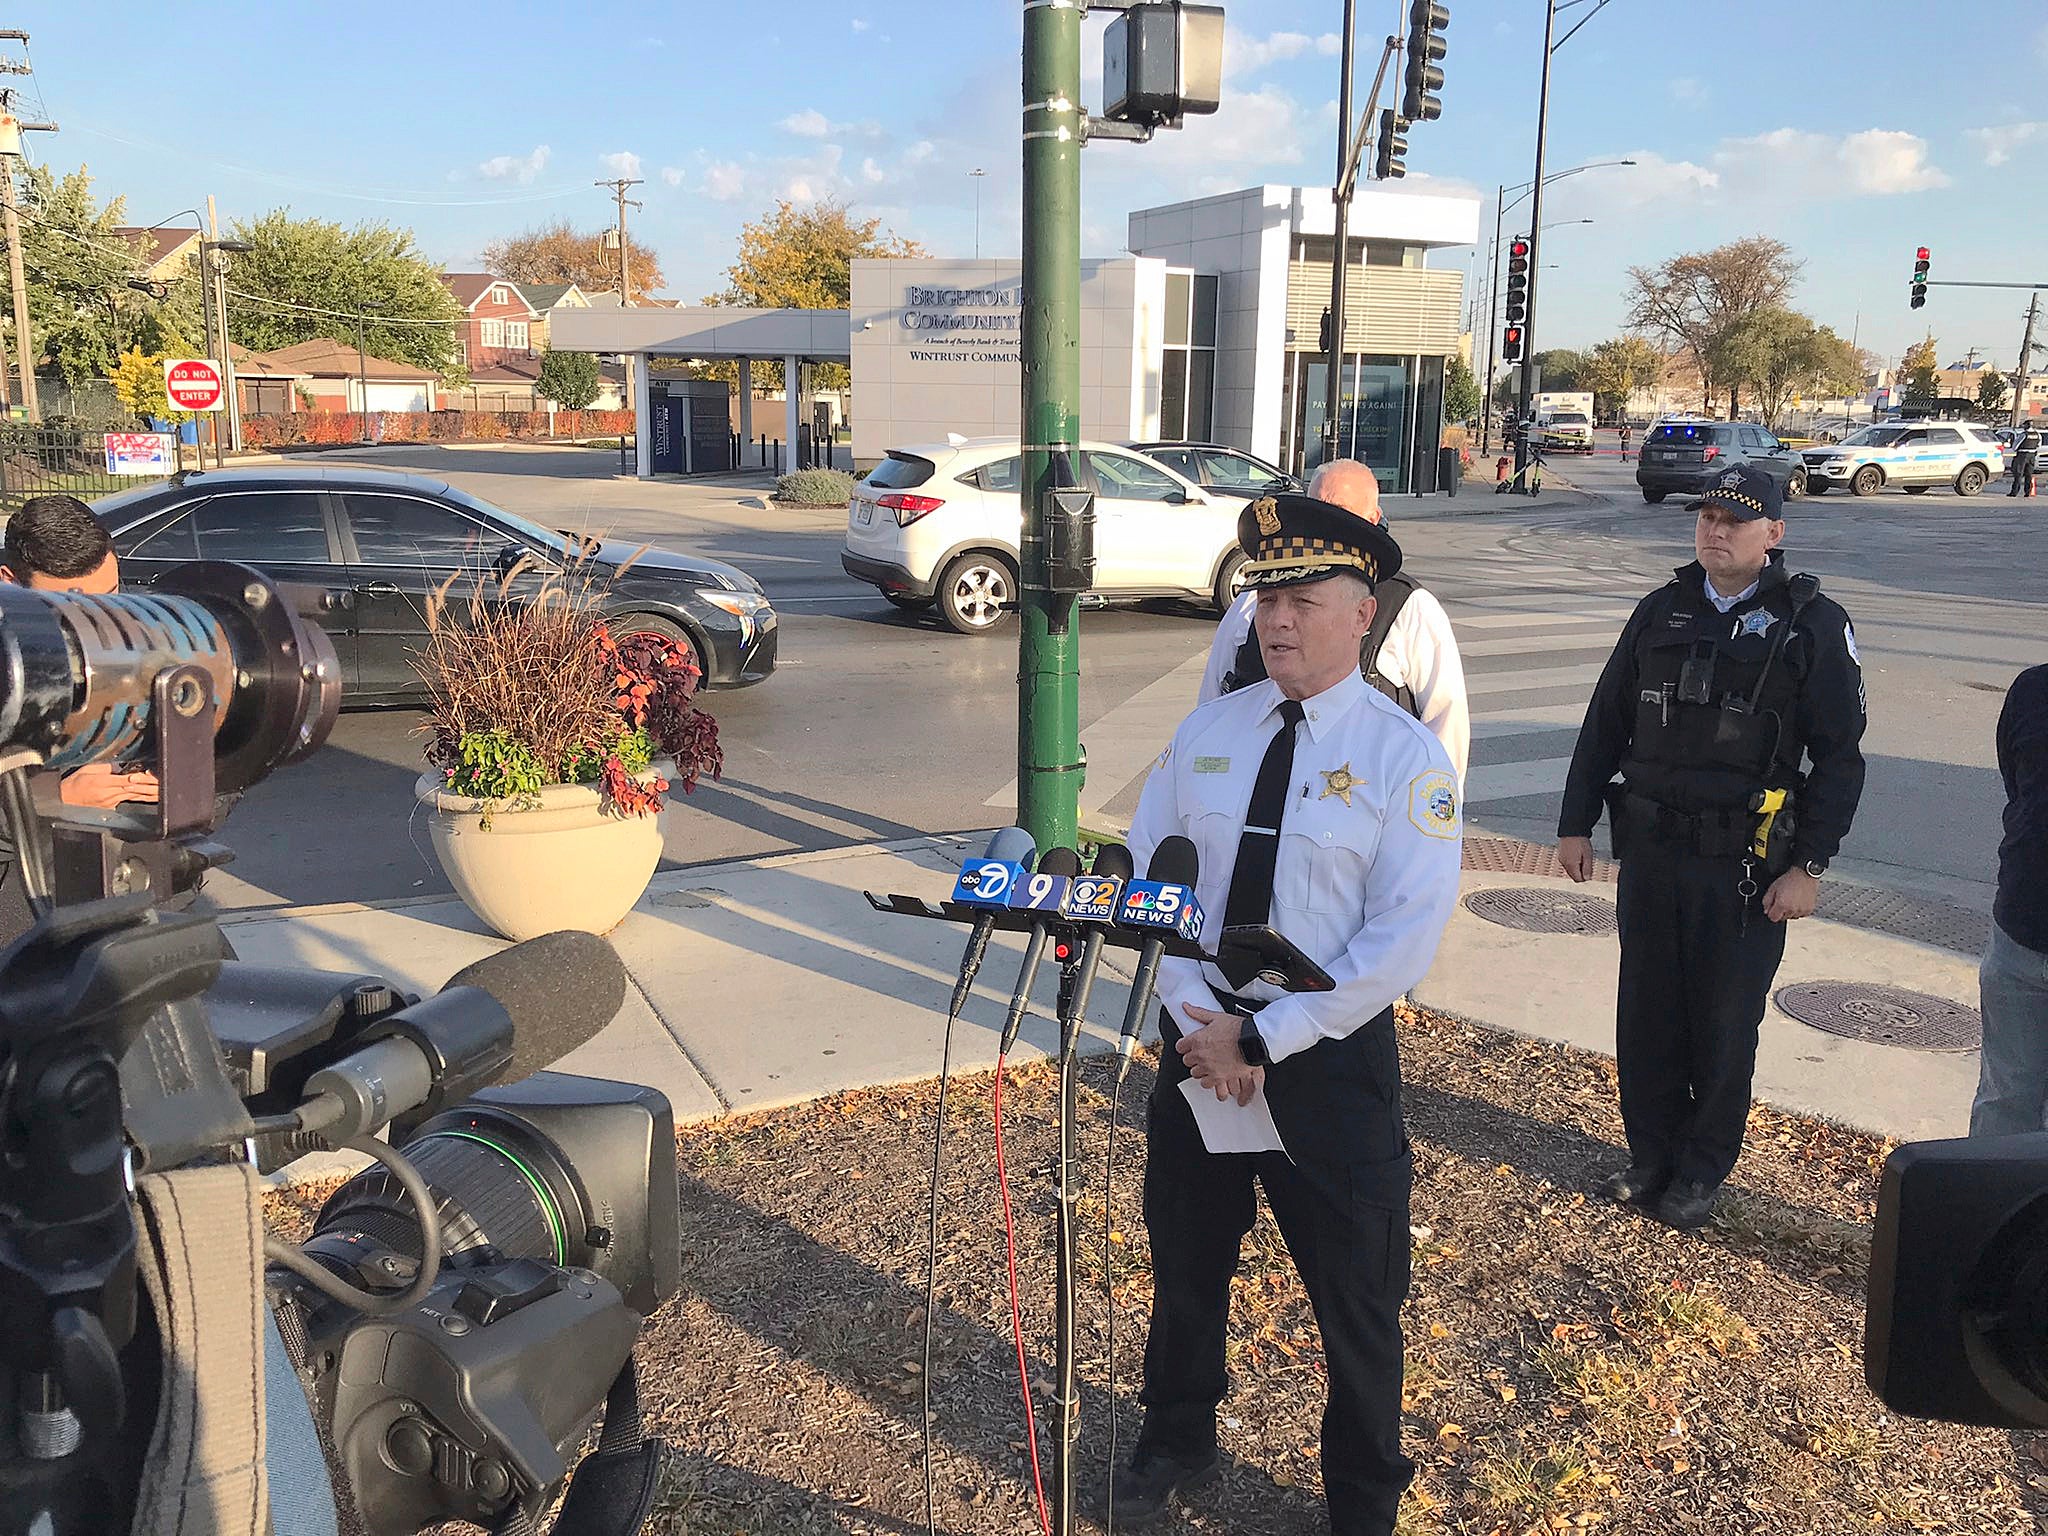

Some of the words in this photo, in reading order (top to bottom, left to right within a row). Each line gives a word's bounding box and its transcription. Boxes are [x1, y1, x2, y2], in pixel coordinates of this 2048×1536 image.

[911, 286, 1011, 306] BRIGHTON
[904, 311, 1018, 330] COMMUNITY
[950, 338, 957, 346] of
[956, 338, 976, 347] Beverly
[910, 351, 969, 361] WINTRUST
[174, 370, 188, 379] DO
[193, 370, 211, 379] NOT
[180, 392, 211, 400] ENTER
[1343, 393, 1368, 401] NEER
[1312, 401, 1327, 409] PAY
[1368, 401, 1396, 410] AGAIN!
[656, 404, 664, 456] WINTRUST
[961, 875, 981, 885] abc
[978, 866, 1007, 898] 7
[1028, 874, 1053, 909] 9
[1094, 882, 1115, 906] 2
[1155, 885, 1183, 912] 5
[1069, 902, 1110, 916] NEWS
[1123, 908, 1175, 925] NEWS
[1190, 907, 1204, 938] 5
[420, 1307, 440, 1318] RET
